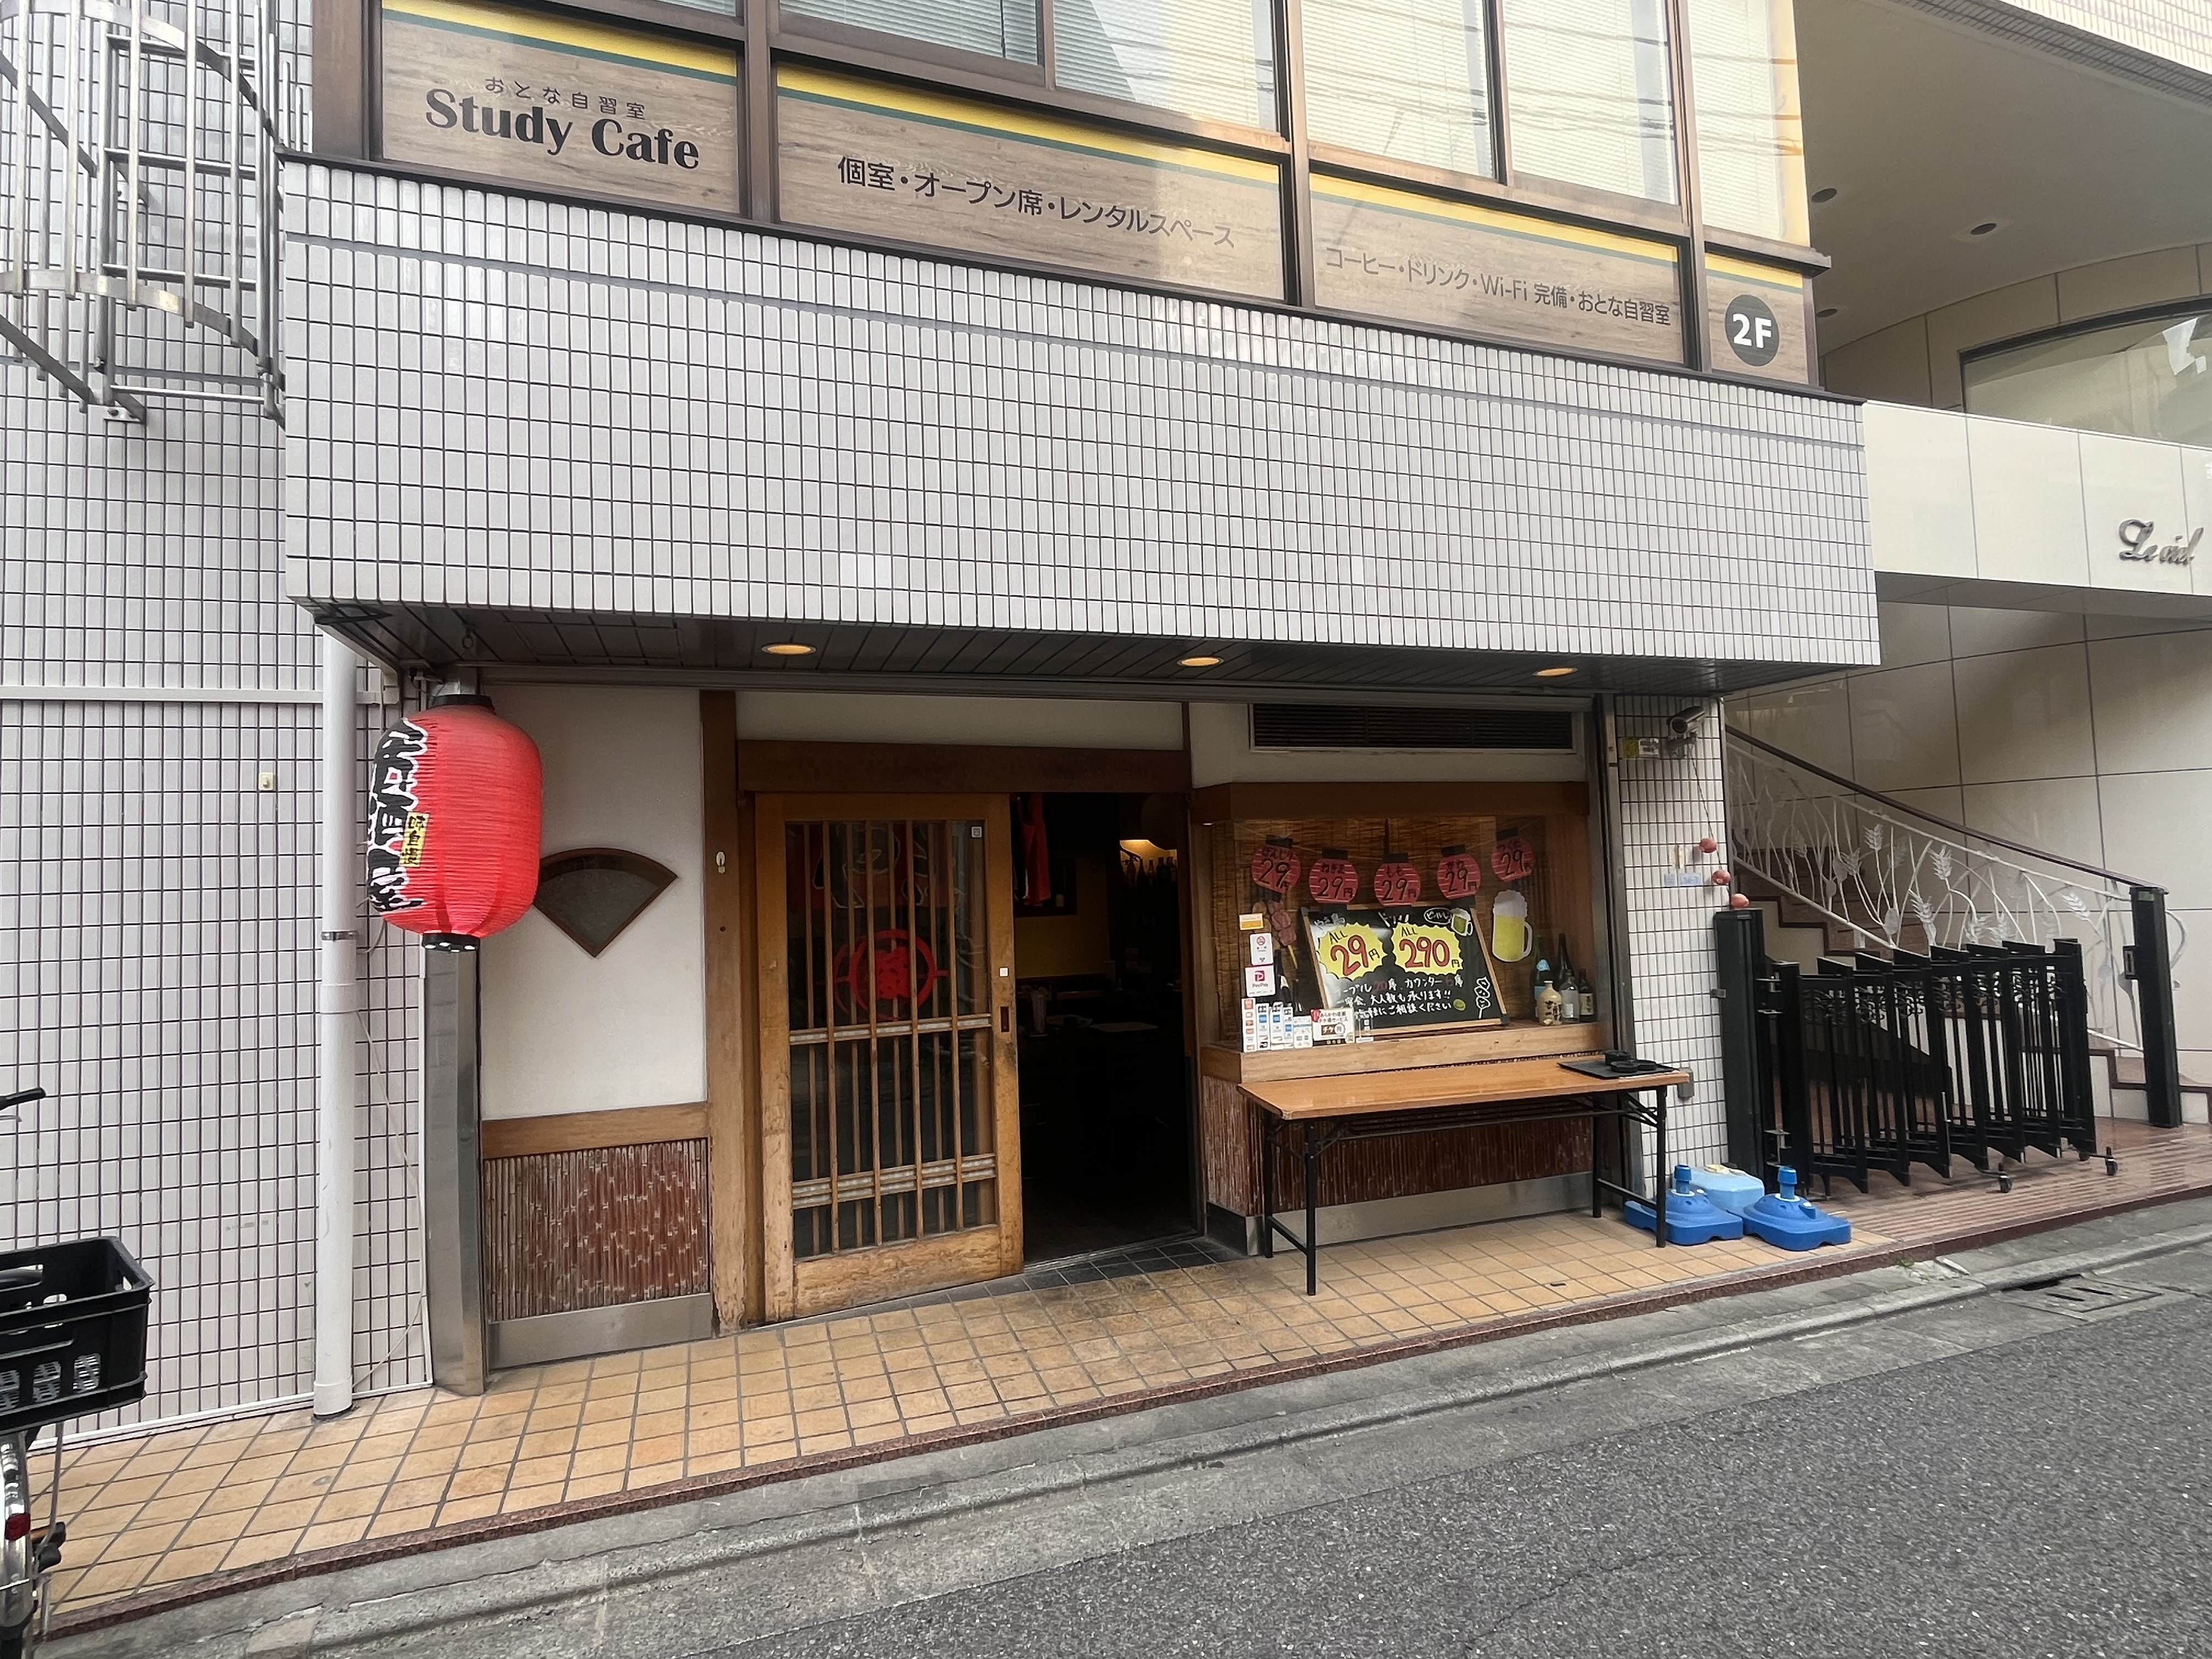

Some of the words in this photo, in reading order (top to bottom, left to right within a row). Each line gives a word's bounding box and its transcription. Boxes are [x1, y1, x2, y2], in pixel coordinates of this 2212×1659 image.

[485, 76, 645, 120] おとな自習室
[426, 88, 573, 156] Study
[591, 118, 699, 170] Cafe
[837, 155, 1235, 248] 個室・オープン席・レンタルスペース
[1731, 312, 1774, 350] 2F
[1329, 929, 1348, 945] ALL
[1401, 927, 1419, 938] ALL
